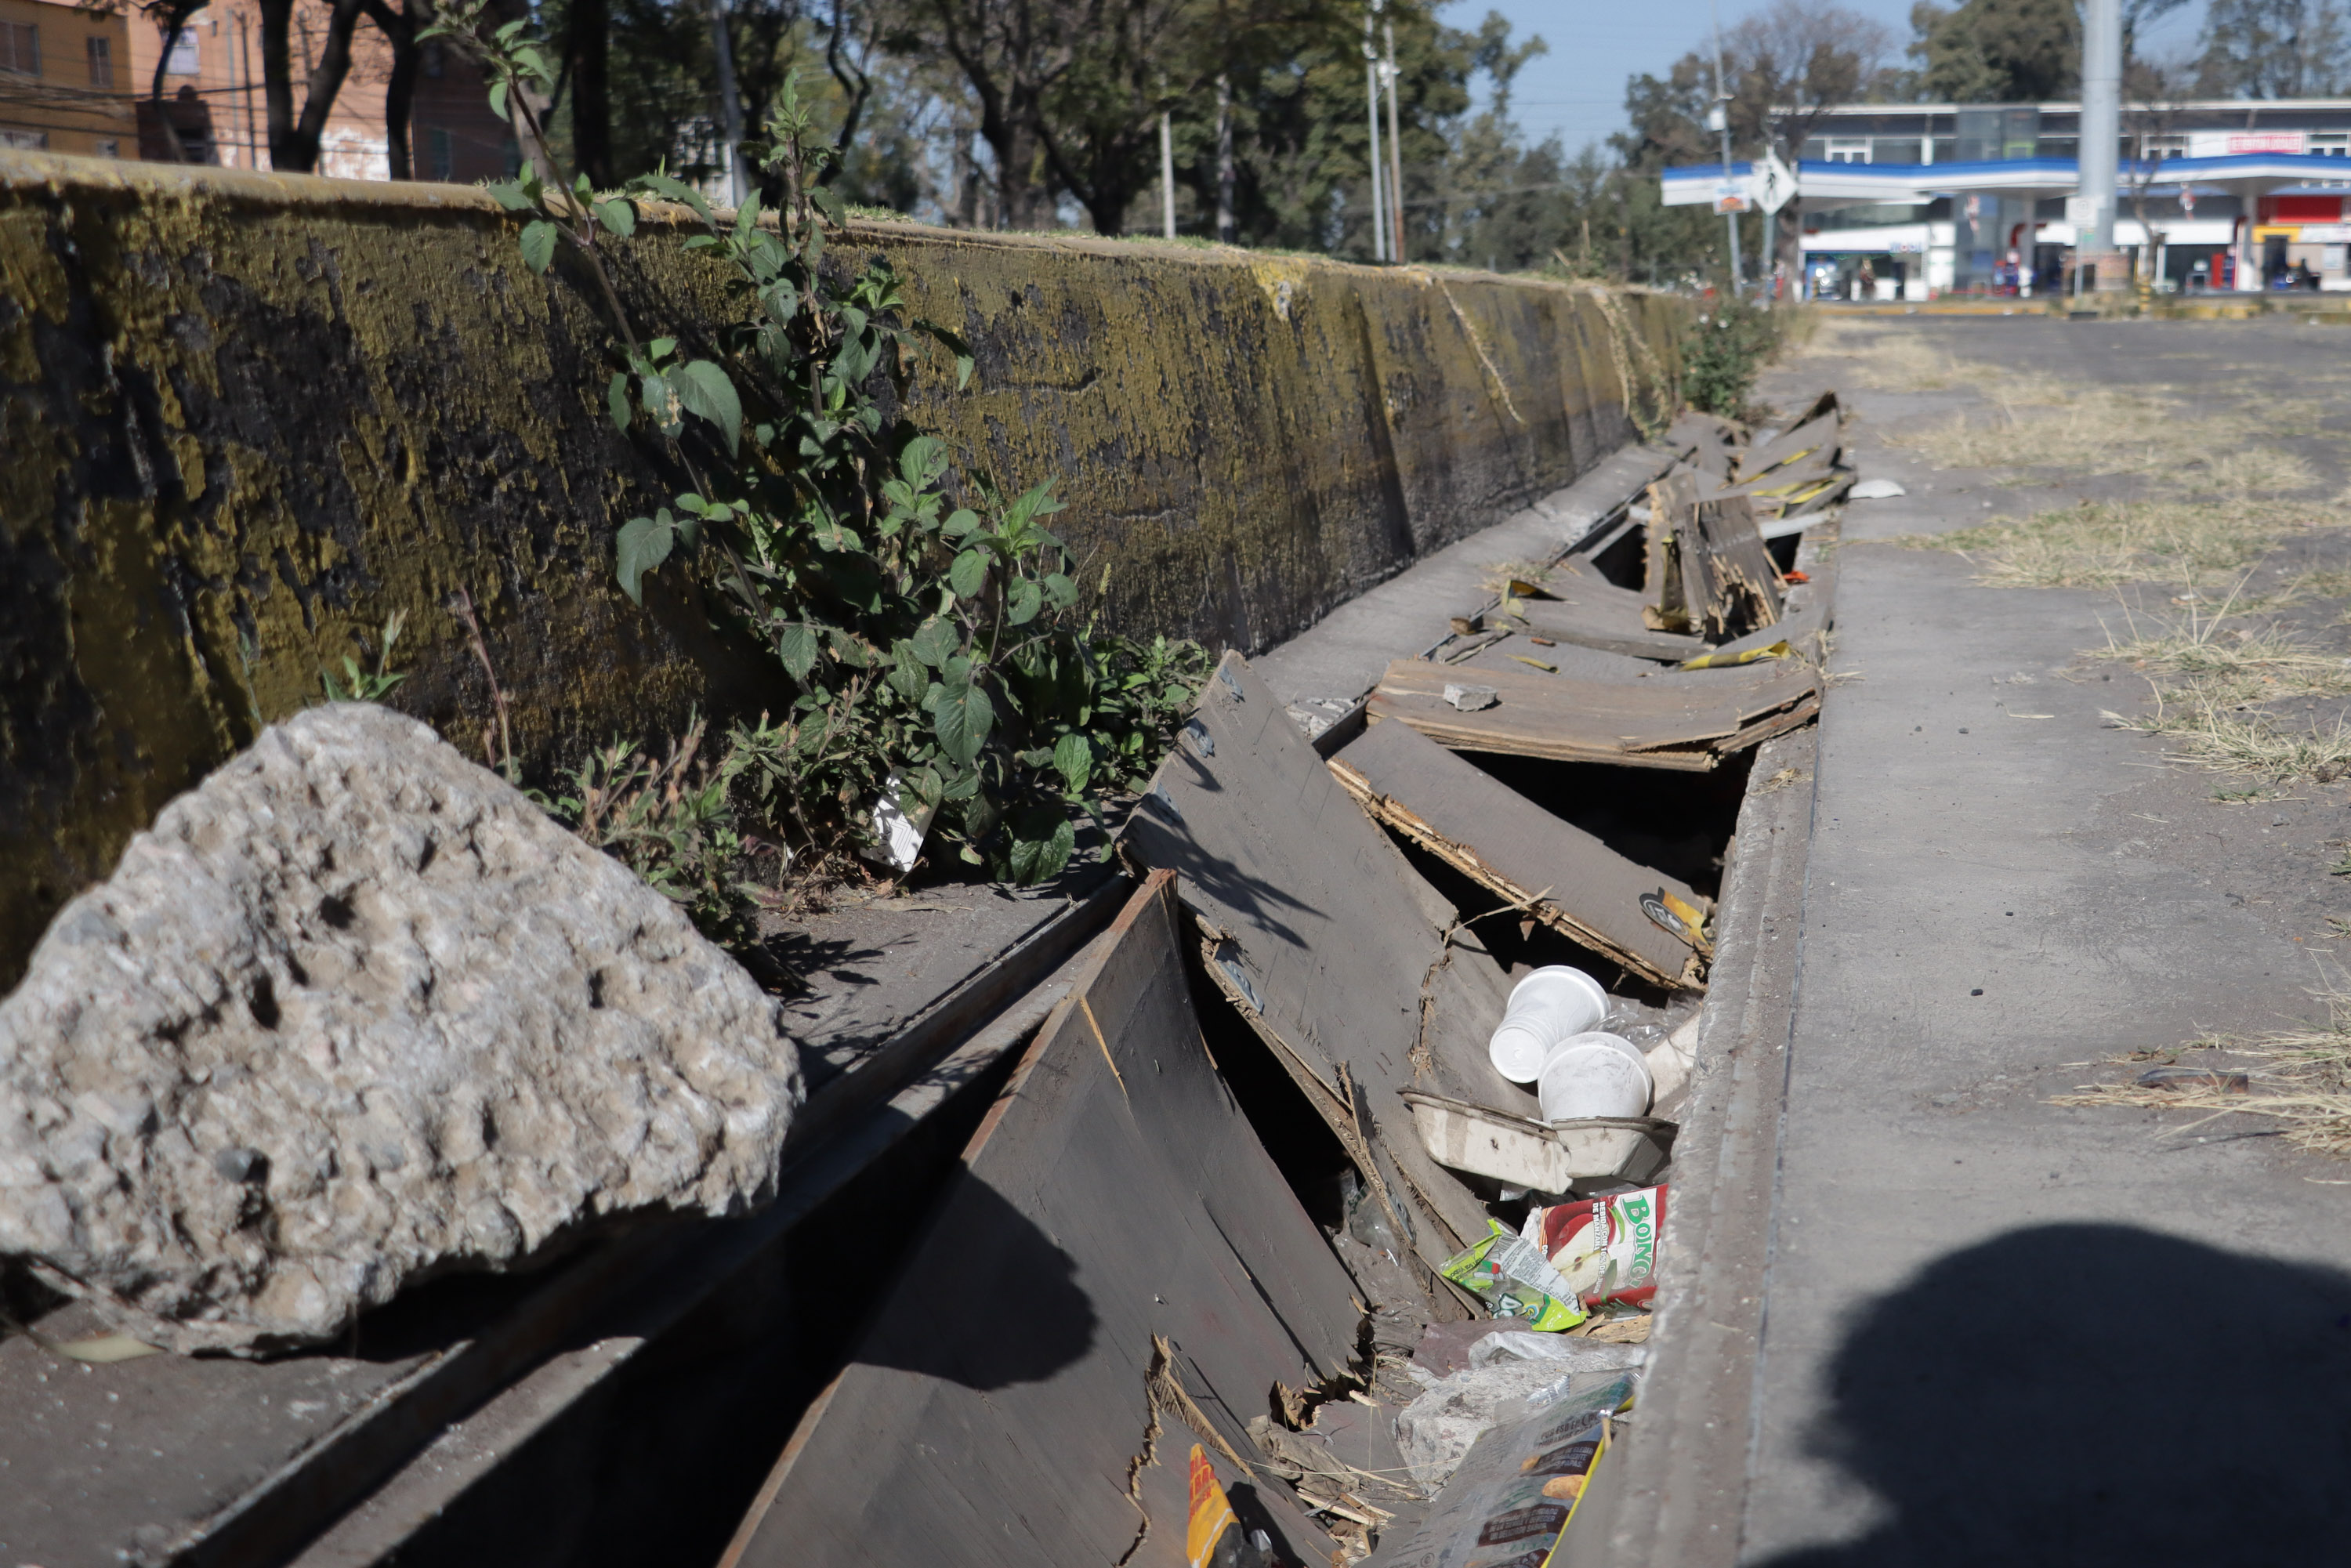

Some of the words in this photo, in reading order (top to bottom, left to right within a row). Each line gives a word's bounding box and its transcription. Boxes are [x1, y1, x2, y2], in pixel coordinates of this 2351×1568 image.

[1592, 1202, 1599, 1214] DE
[1599, 1200, 1608, 1229] BEBIDA
[1592, 1214, 1601, 1251] MANZANA
[1598, 1264, 1606, 1275] DE
[1593, 1276, 1604, 1294] JUGO
